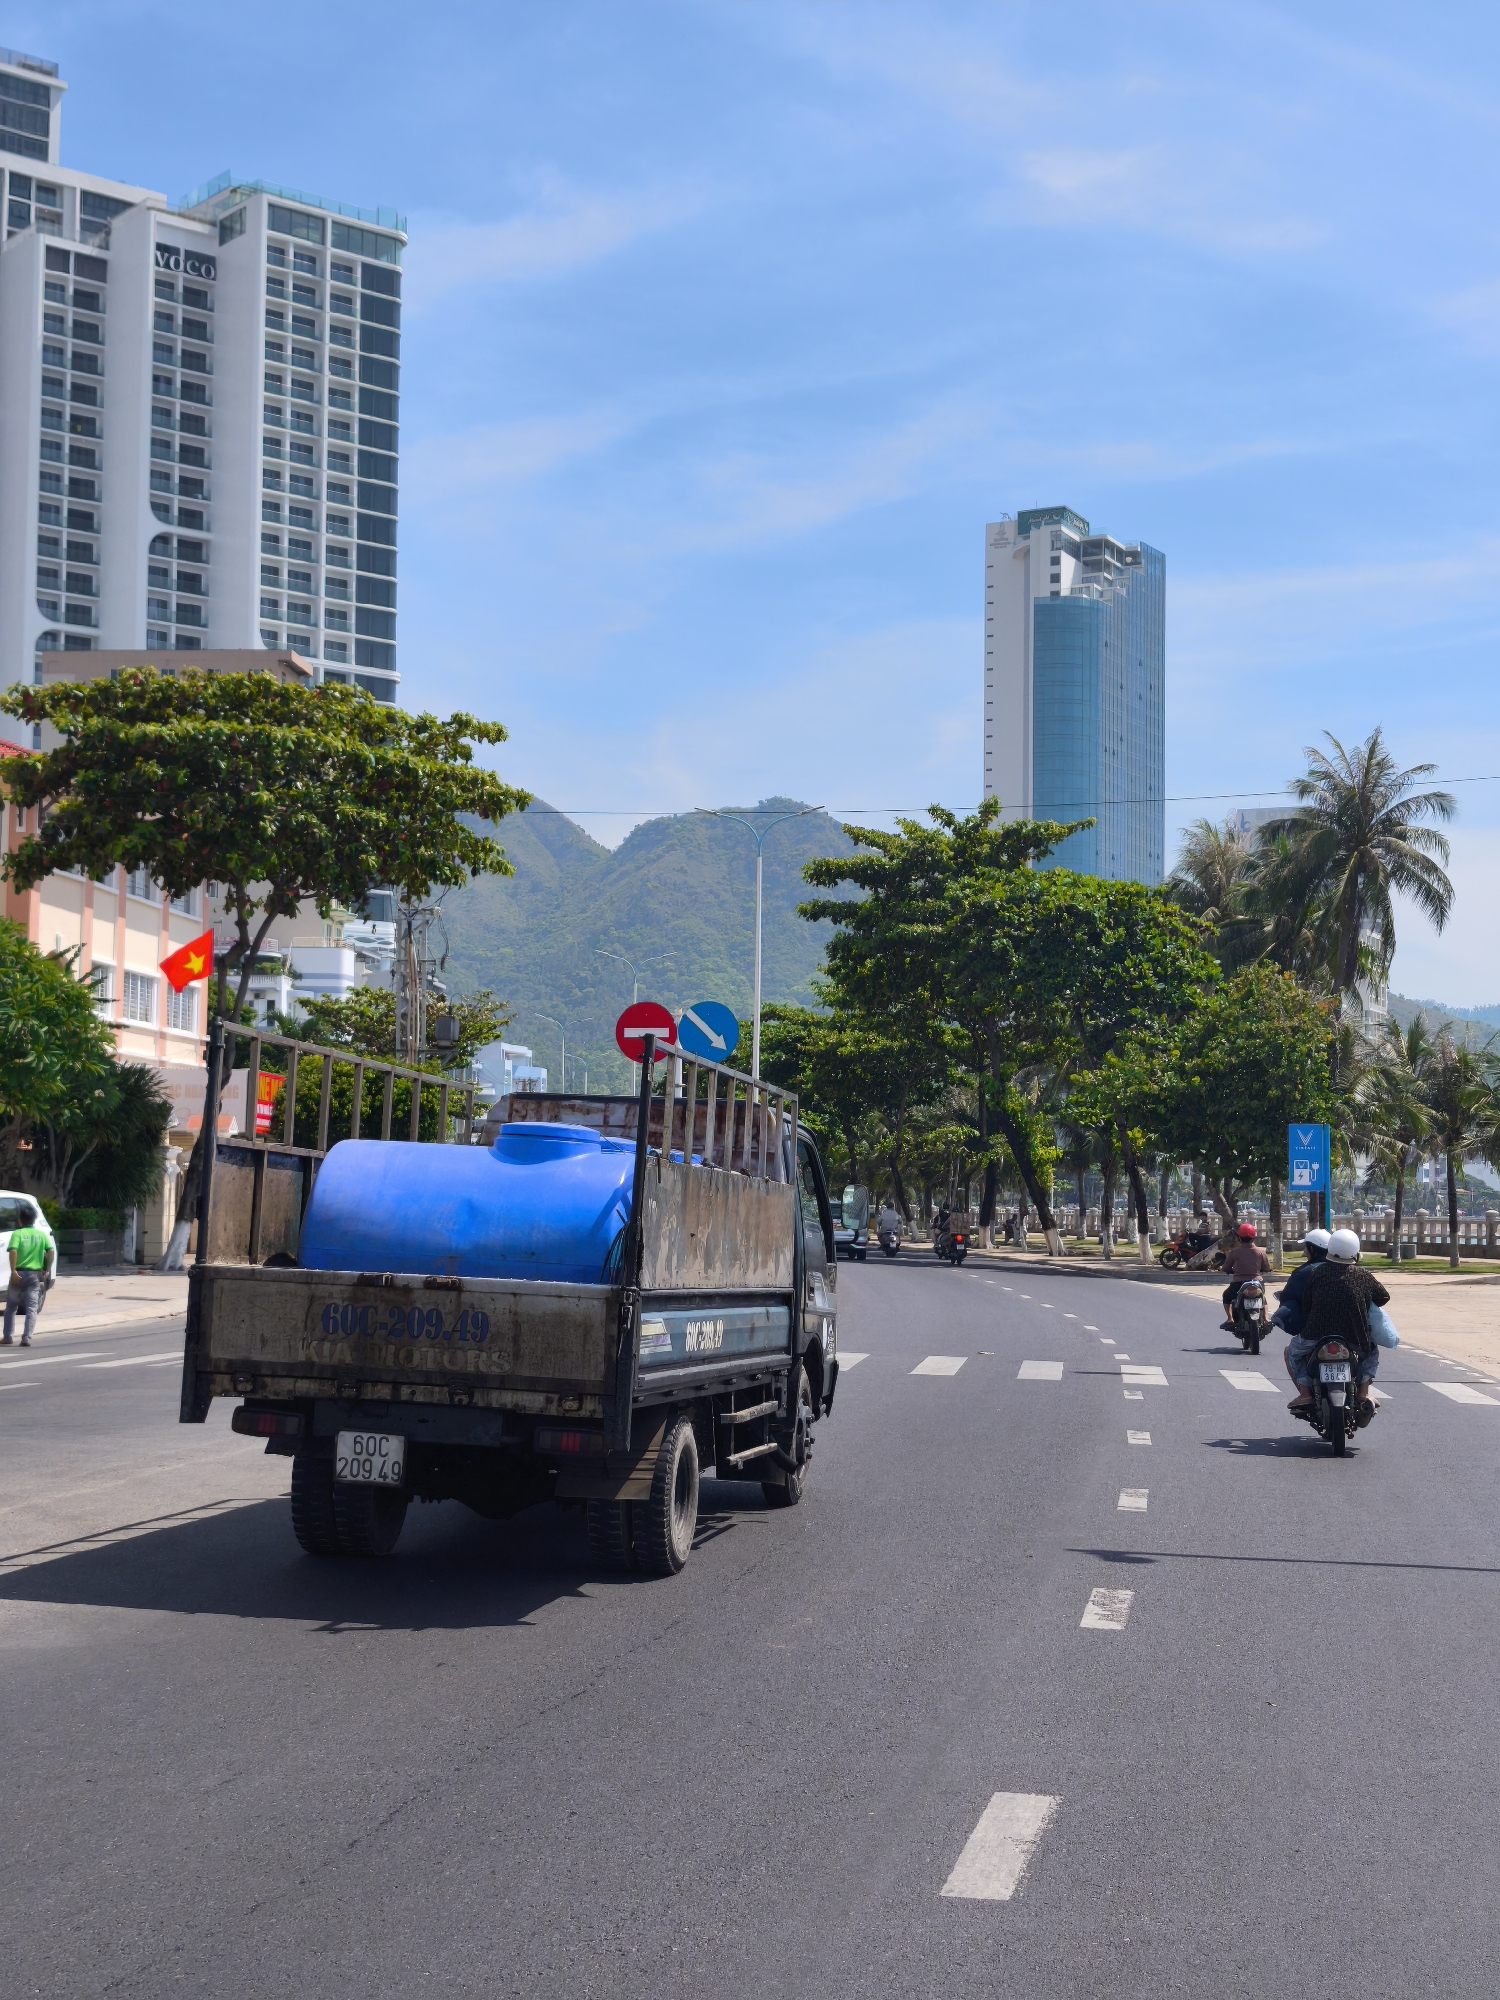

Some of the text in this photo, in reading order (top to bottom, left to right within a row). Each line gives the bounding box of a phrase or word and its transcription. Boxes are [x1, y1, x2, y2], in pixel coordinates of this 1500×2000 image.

[156, 251, 215, 279] voco
[321, 1302, 490, 1344] 60C-209.49
[298, 1340, 512, 1374] KIA MOTORS
[1324, 1363, 1346, 1373] 79-H2
[353, 1434, 390, 1458] 60C
[337, 1456, 401, 1482] 209.49
